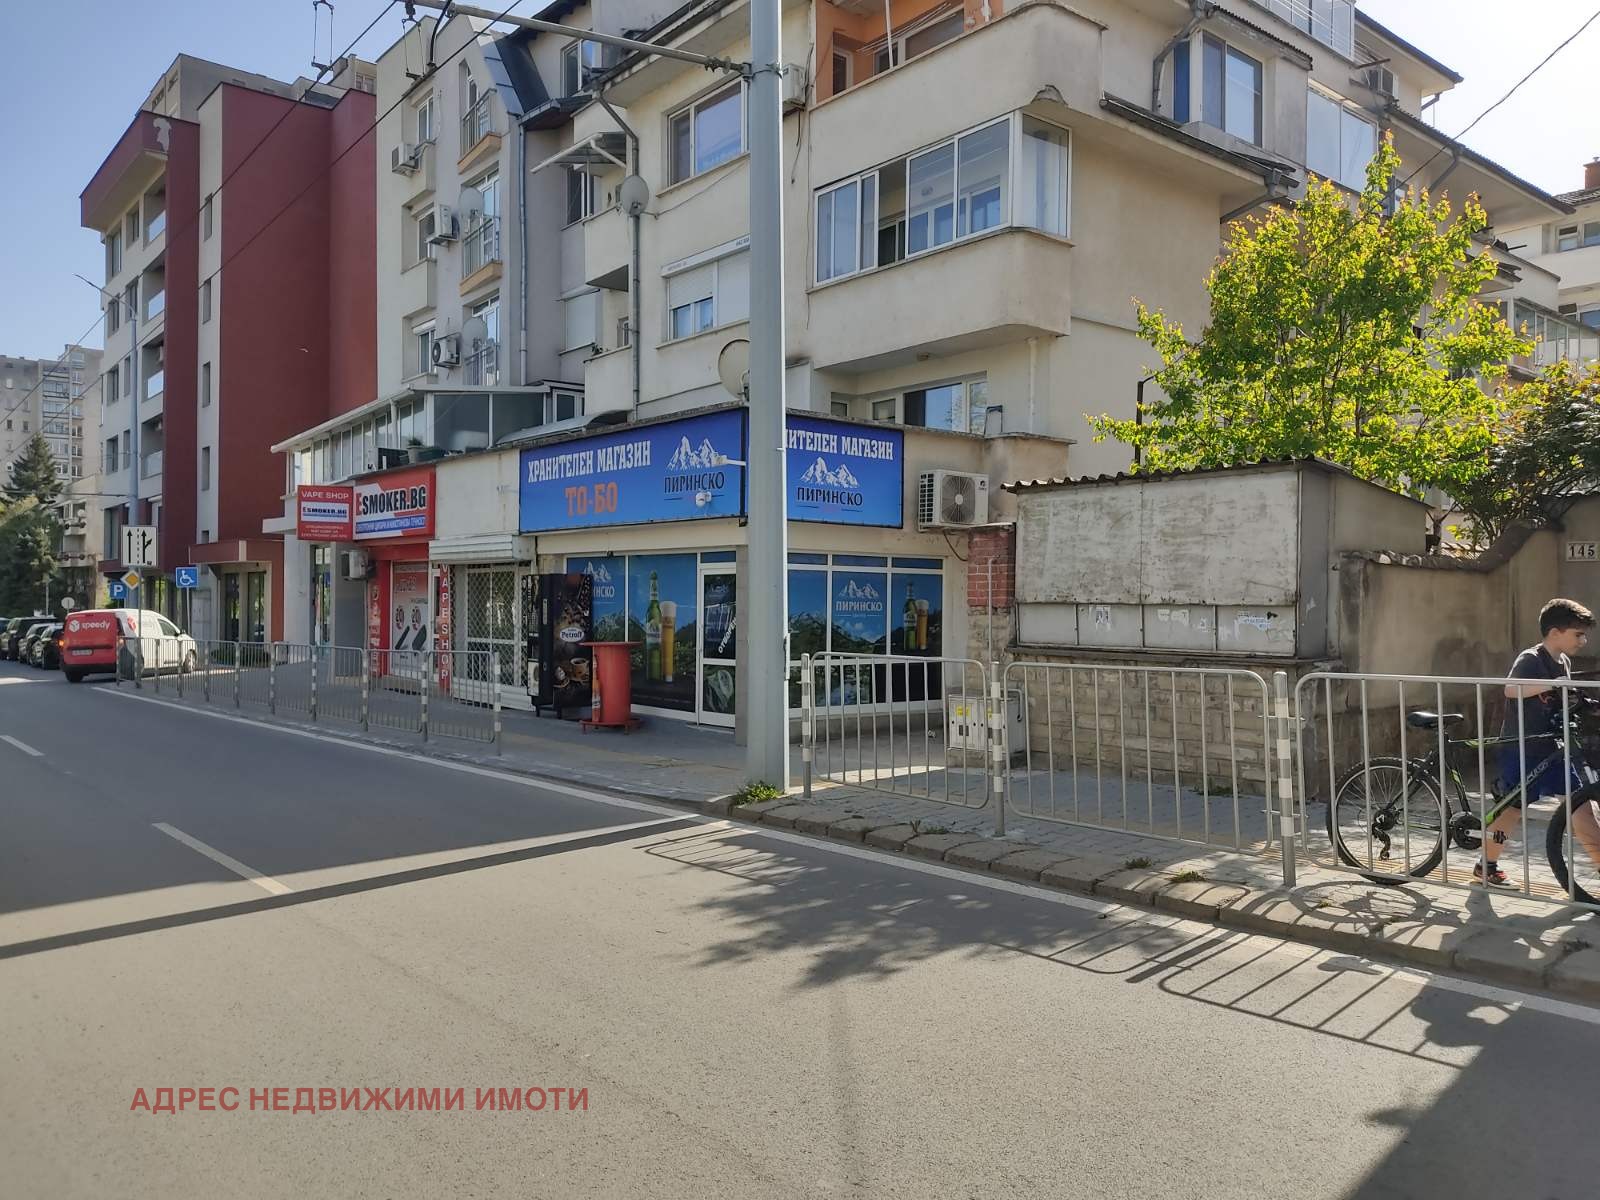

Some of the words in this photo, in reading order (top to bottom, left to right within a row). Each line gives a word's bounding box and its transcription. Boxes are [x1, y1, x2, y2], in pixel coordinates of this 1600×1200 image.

[786, 428, 838, 453] ИТЕЛЕН
[841, 435, 894, 460] МАГАЗИН
[527, 449, 594, 483] ХРАНИТЕЛЕН
[597, 440, 651, 473] МАГАЗИН
[664, 471, 725, 493] ПИРИНСКО
[301, 491, 323, 499] VAPE
[326, 491, 349, 500] SHOP
[355, 486, 427, 516] ESMOKER.BG
[564, 481, 619, 519] ТО-БО
[797, 486, 863, 507] ПИРИНСКО
[1569, 544, 1595, 557] 145
[835, 600, 883, 612] ПИРИНСКО
[82, 620, 111, 631] speedy
